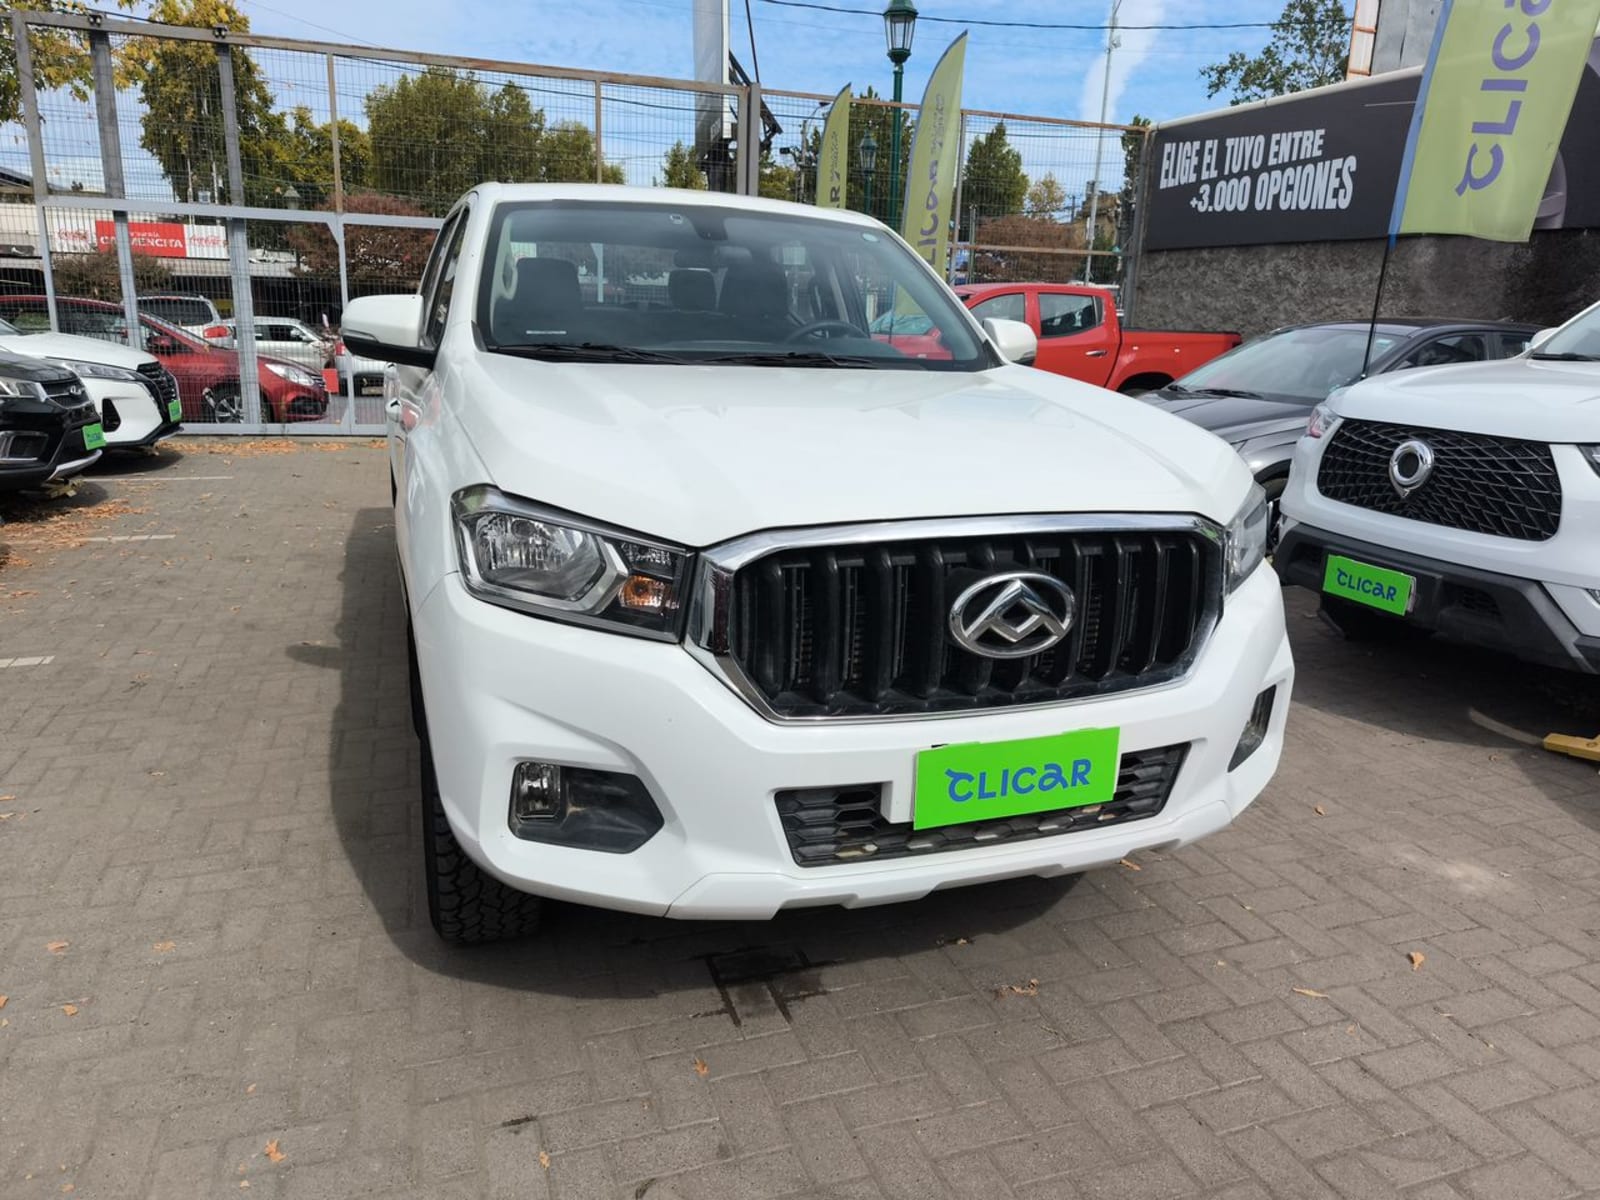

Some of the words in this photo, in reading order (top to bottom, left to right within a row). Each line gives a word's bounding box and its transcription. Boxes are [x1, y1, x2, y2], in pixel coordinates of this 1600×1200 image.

[1159, 140, 1201, 190] ELIGE
[1201, 139, 1219, 181] EL
[1223, 134, 1265, 176] TUYO
[1268, 128, 1327, 166] ENTRE
[1189, 175, 1251, 213] +3.000
[1254, 155, 1358, 212] OPCIONES
[944, 758, 1092, 803] CLICaR
